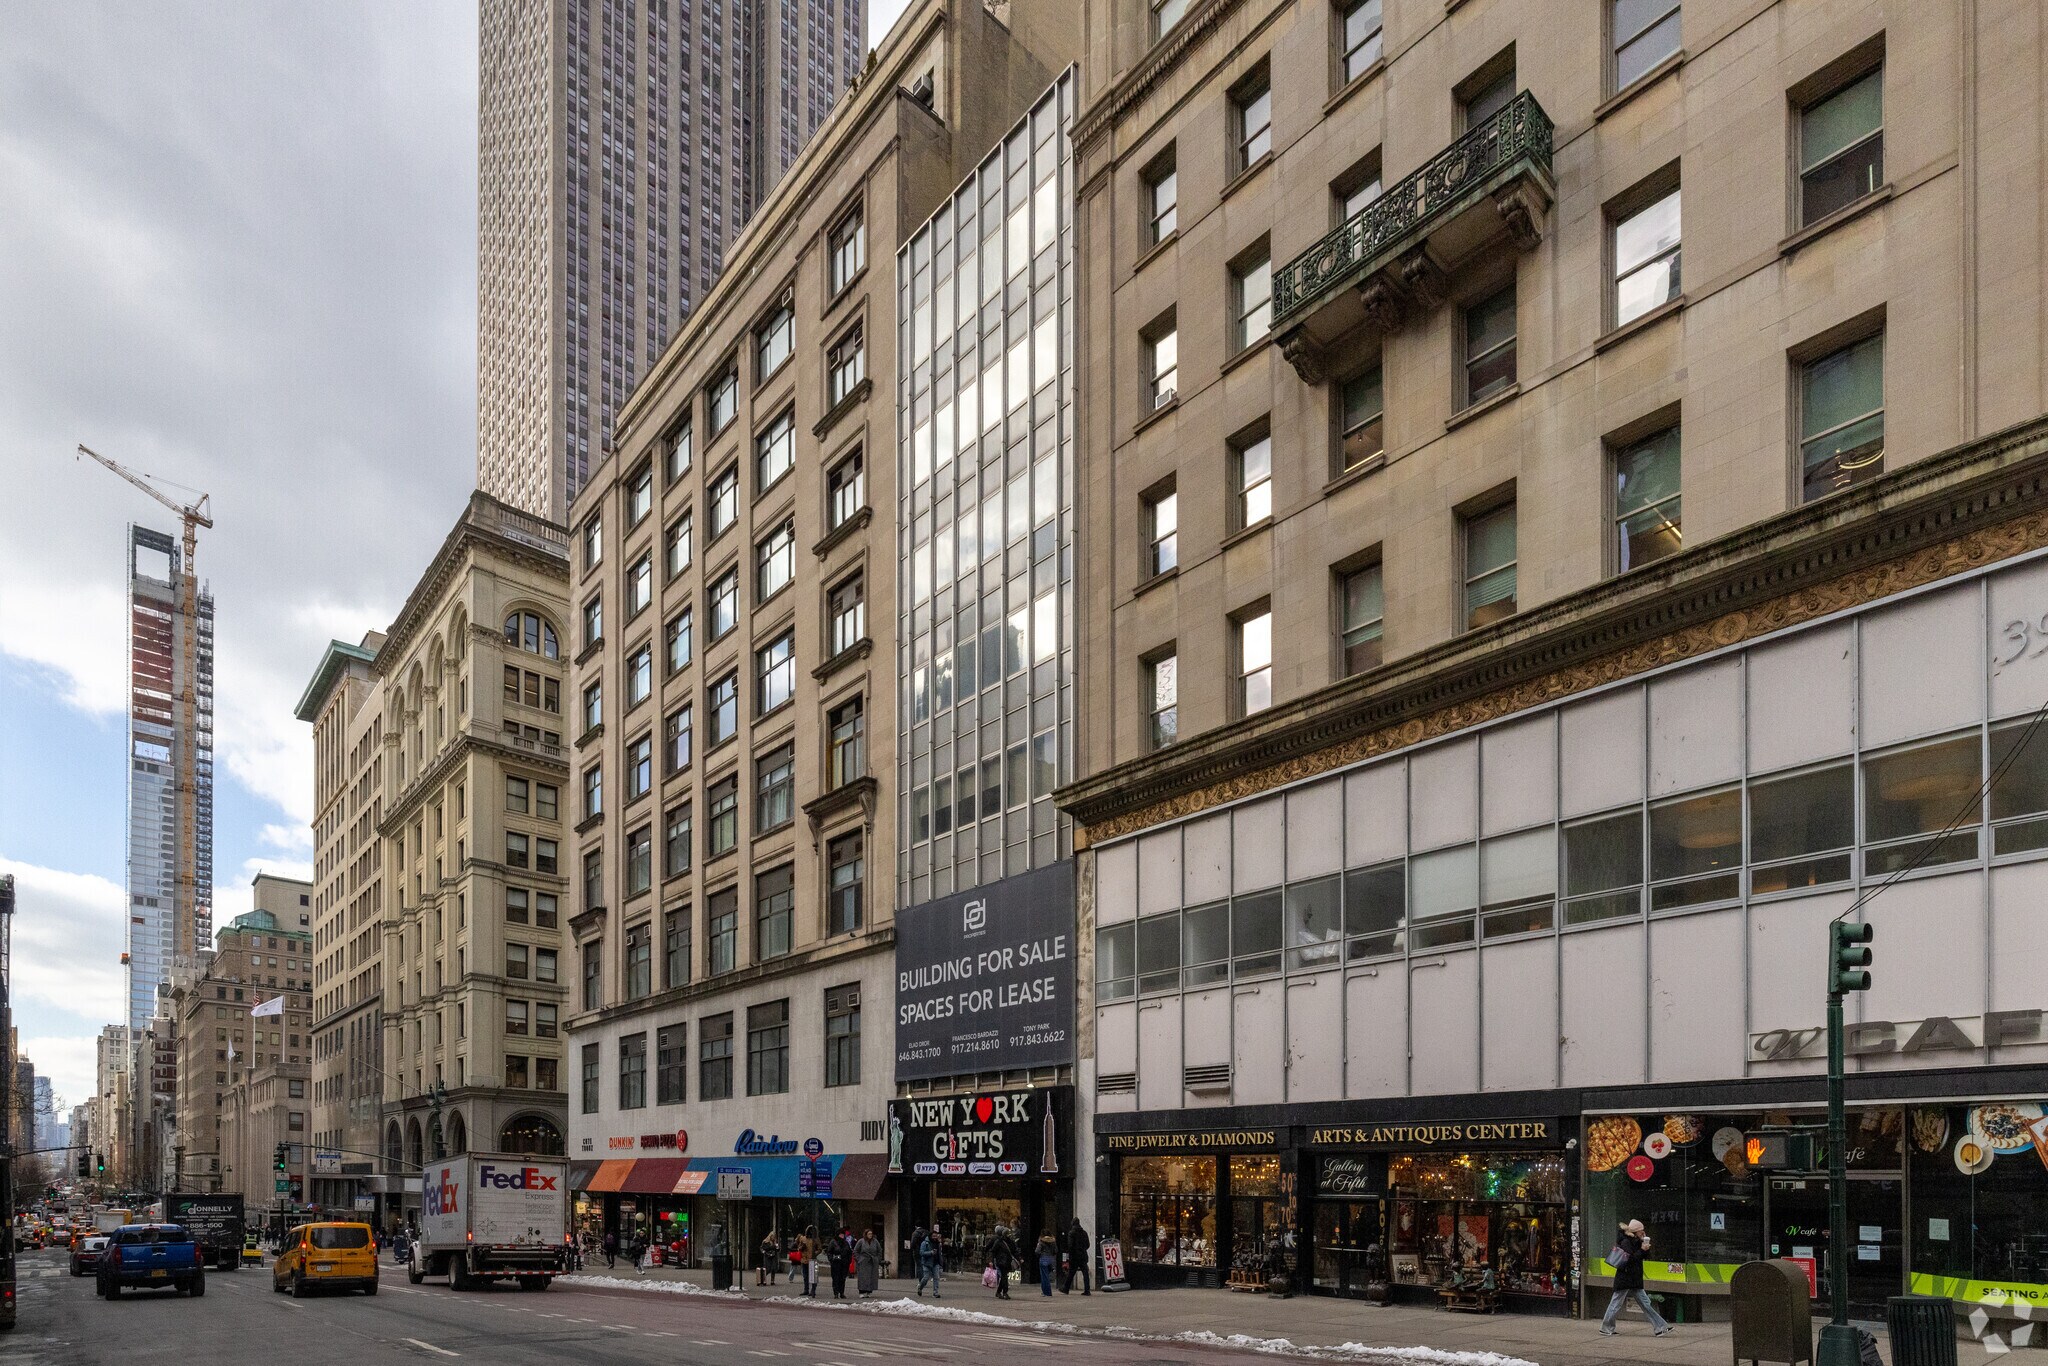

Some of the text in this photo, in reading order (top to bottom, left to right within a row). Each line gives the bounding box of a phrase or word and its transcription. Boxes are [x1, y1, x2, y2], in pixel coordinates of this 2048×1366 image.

[900, 935, 1066, 992] BUILDING FOR SALE
[900, 977, 1055, 1025] SPACES FOR LEASE
[952, 1030, 999, 1042] FRANCESCO BARDAZZI
[1023, 1022, 1050, 1033] TONY PARK
[951, 1039, 1000, 1054] 917.214.8610
[1009, 1030, 1065, 1047] 917.843.6622
[898, 1047, 941, 1062] 646.843.1700
[910, 1100, 955, 1128] NEW
[860, 1120, 886, 1141] JUDY
[1312, 1122, 1547, 1145] ARTS & ANTIQUES CENTER
[734, 1128, 798, 1153] Rainbow
[1108, 1131, 1275, 1150] FINE JEWELRY & DIAMONDS
[1844, 1147, 1865, 1163] afé
[921, 1164, 936, 1172] NYPD
[947, 1164, 965, 1172] FDNY
[1322, 1157, 1365, 1179] Gallery
[480, 1165, 557, 1191] FedEx
[1320, 1172, 1369, 1192] at Fifth
[423, 1168, 459, 1216] FedEx
[525, 1192, 554, 1201] Express
[1714, 1216, 1723, 1226] A
[1800, 1228, 1817, 1237] café
[1982, 1288, 2039, 1299] SEATING
